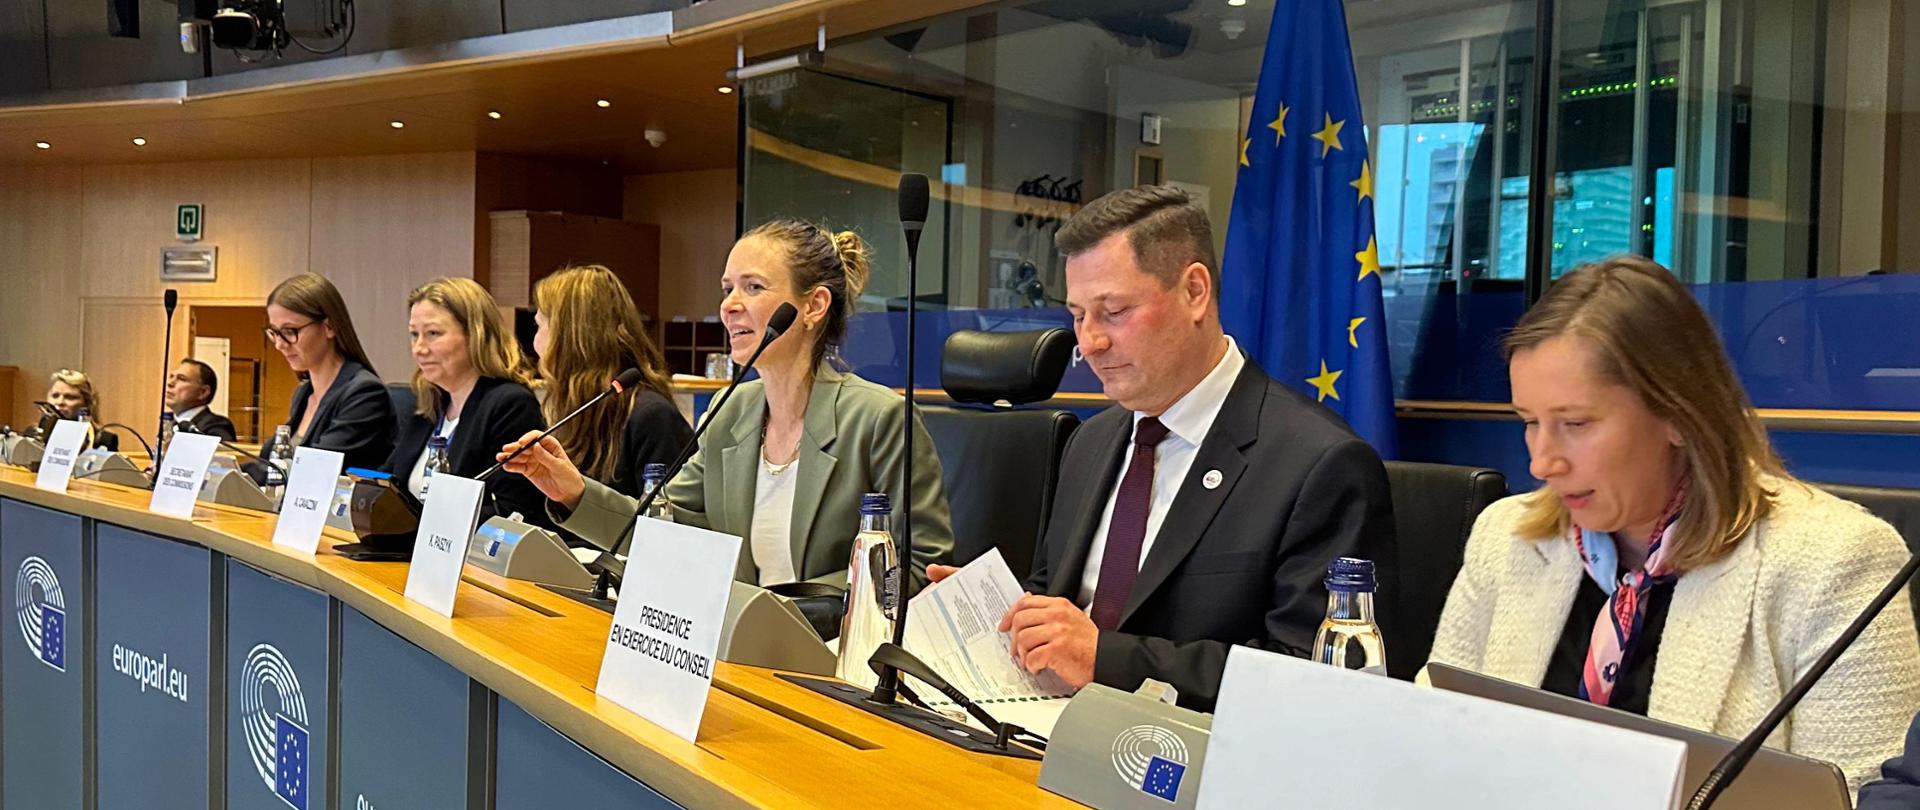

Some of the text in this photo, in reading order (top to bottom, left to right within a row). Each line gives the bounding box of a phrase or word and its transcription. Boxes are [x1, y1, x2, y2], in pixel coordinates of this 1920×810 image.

[640, 605, 692, 640] PRESIDENCE
[113, 644, 187, 702] europarl.eu
[611, 624, 710, 680] EN EXERCICE DU CONSEIL
